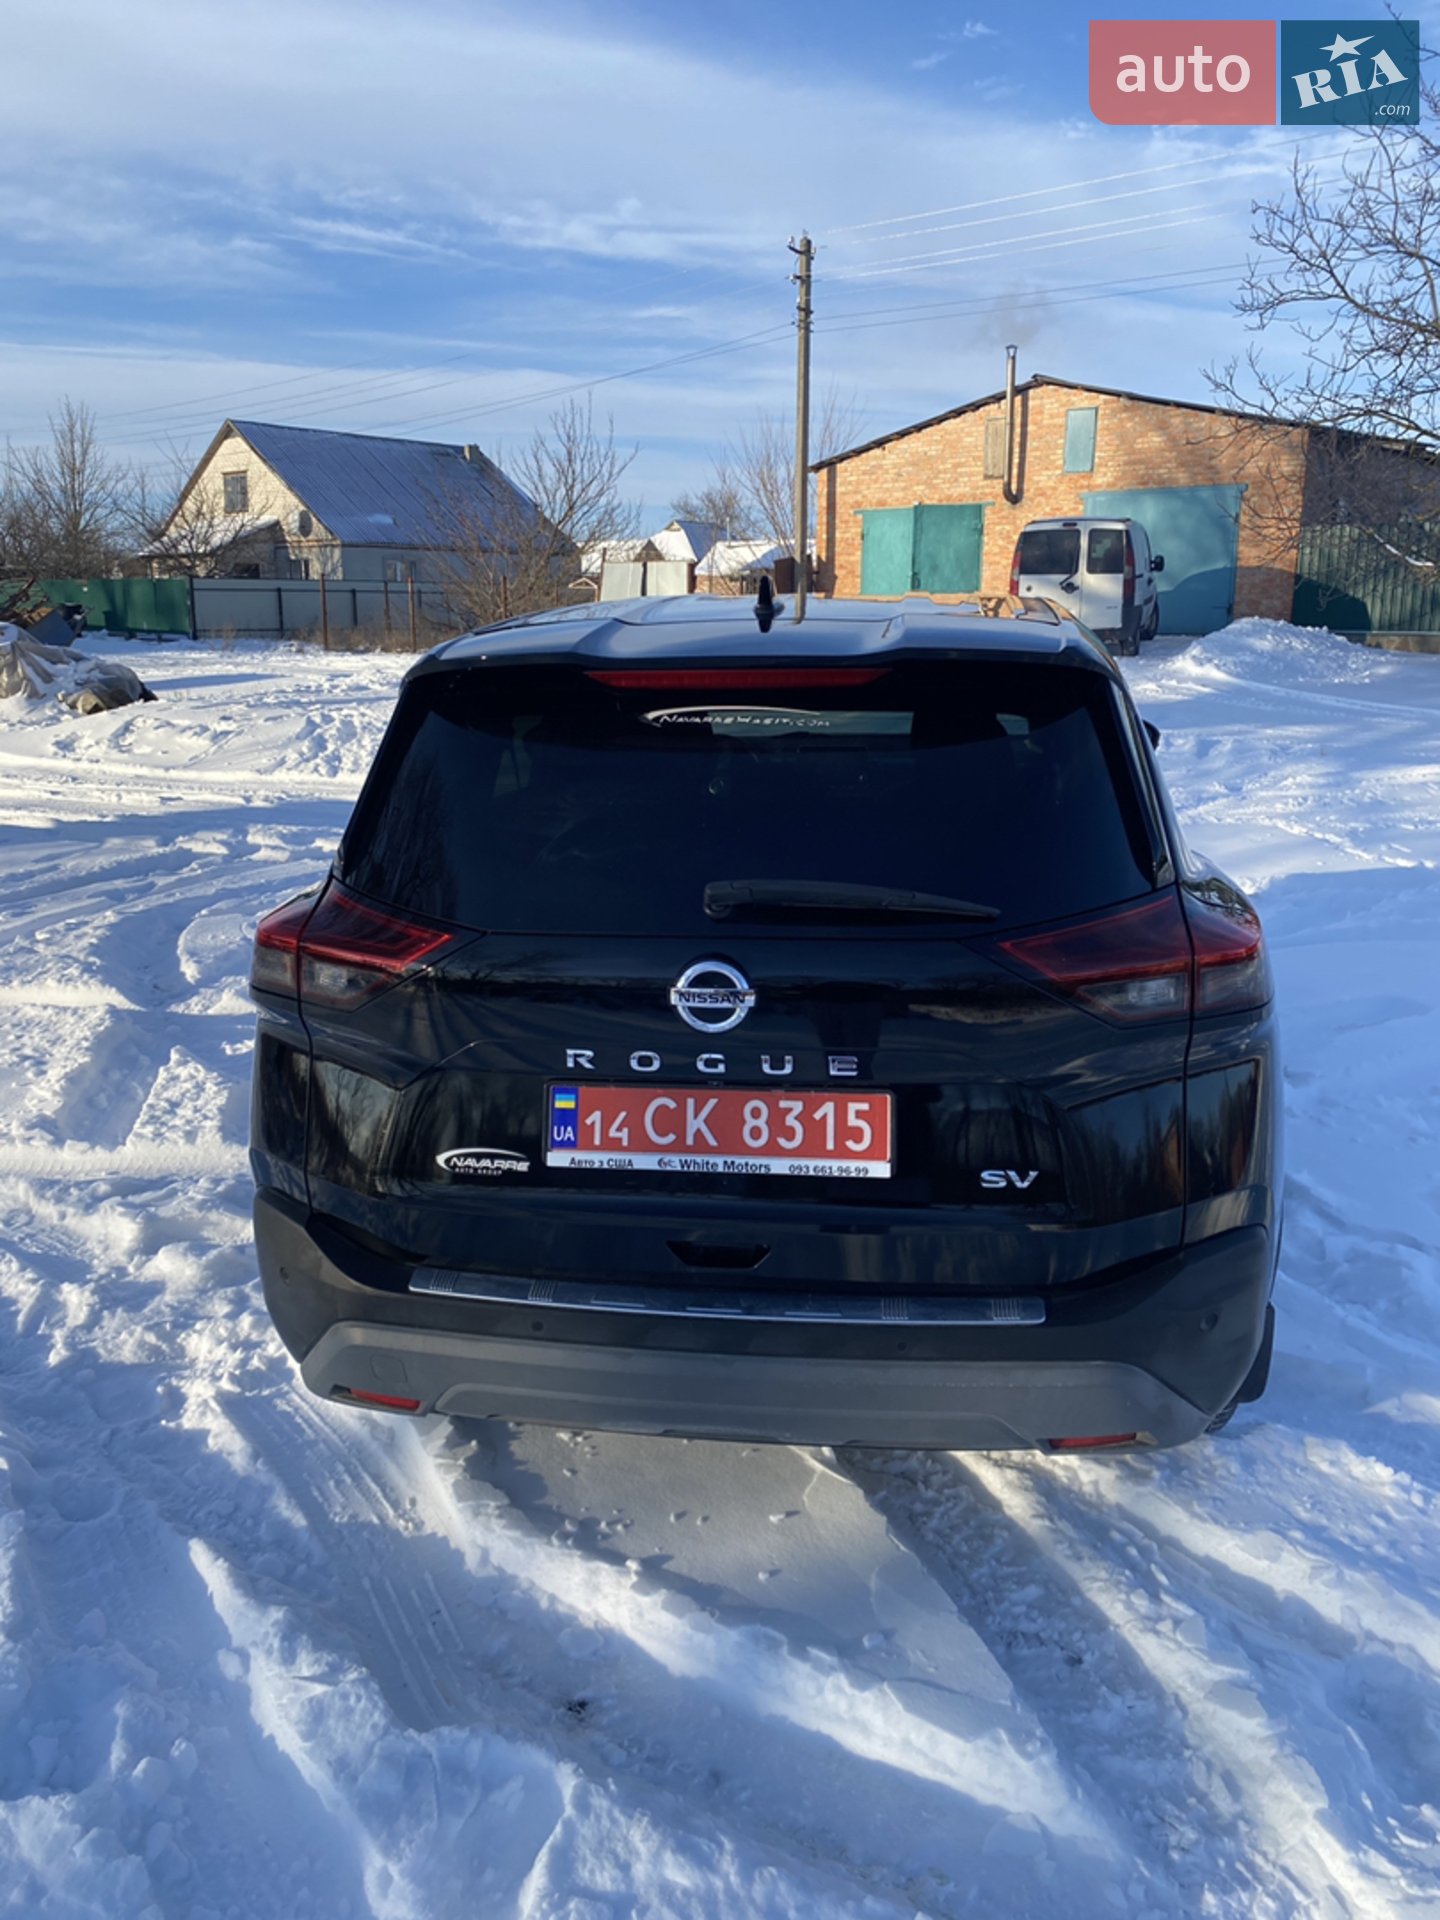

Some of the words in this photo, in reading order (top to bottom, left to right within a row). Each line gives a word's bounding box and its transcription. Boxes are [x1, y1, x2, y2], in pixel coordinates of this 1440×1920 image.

[678, 991, 747, 1005] NISSAN
[565, 1049, 859, 1077] ROGUE
[584, 1110, 630, 1147] 14
[643, 1096, 719, 1146] CK
[742, 1099, 873, 1152] 8315
[553, 1125, 576, 1142] UA
[450, 1157, 530, 1172] NAVARRE
[568, 1157, 595, 1168] Авто
[606, 1158, 635, 1169] США
[679, 1158, 719, 1171] White
[723, 1160, 772, 1174] Motors
[788, 1164, 810, 1175] 093
[980, 1169, 1040, 1189] SV
